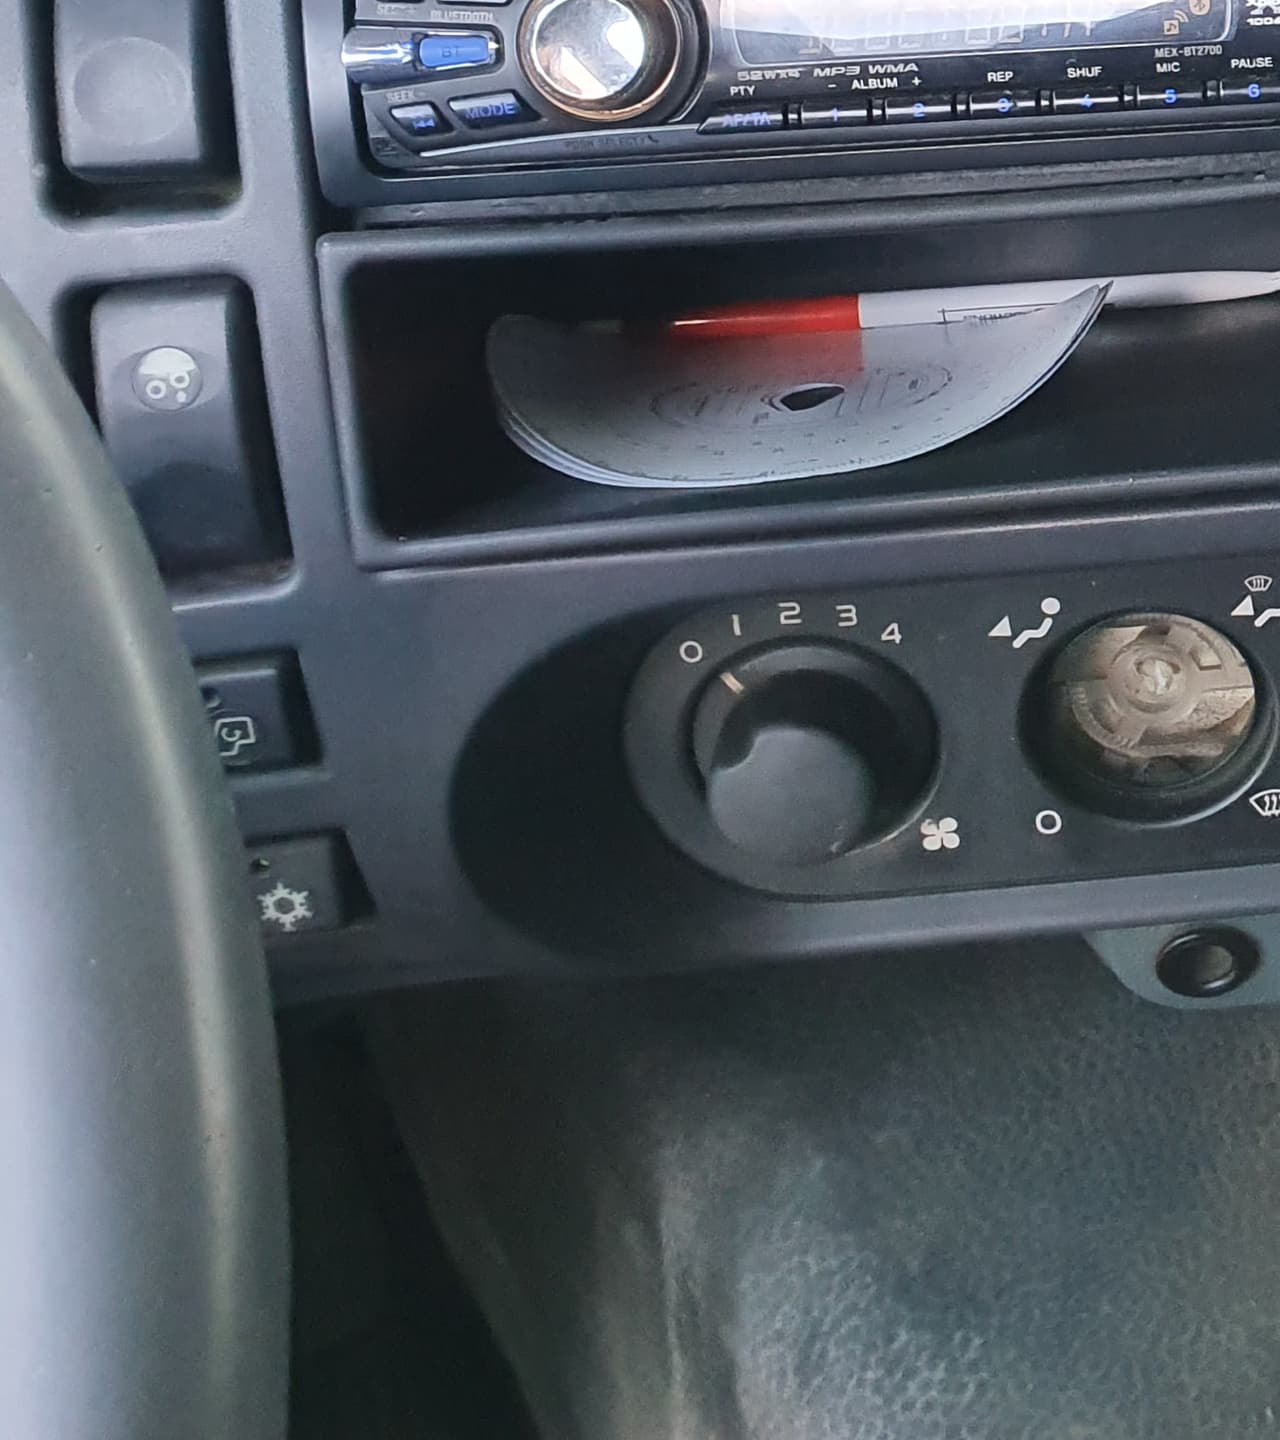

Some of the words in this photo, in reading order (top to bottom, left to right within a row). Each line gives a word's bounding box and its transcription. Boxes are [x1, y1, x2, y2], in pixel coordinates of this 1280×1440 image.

[1154, 45, 1223, 58] MEX-BT2700
[813, 66, 860, 78] MP3
[868, 62, 919, 74] WMA
[1156, 62, 1181, 73] MIC
[1230, 58, 1273, 69] PAUSE
[987, 71, 1014, 83] REP
[1066, 66, 1103, 79] SHUF
[851, 76, 898, 90] ALBUM
[730, 85, 755, 97] PTY
[912, 102, 926, 117] 2
[1164, 89, 1177, 103] 5
[1248, 84, 1261, 98] 6
[465, 103, 516, 119] MODE
[732, 614, 742, 637] 1
[778, 601, 802, 625] 2
[835, 604, 858, 627] 3
[880, 622, 902, 645] 4
